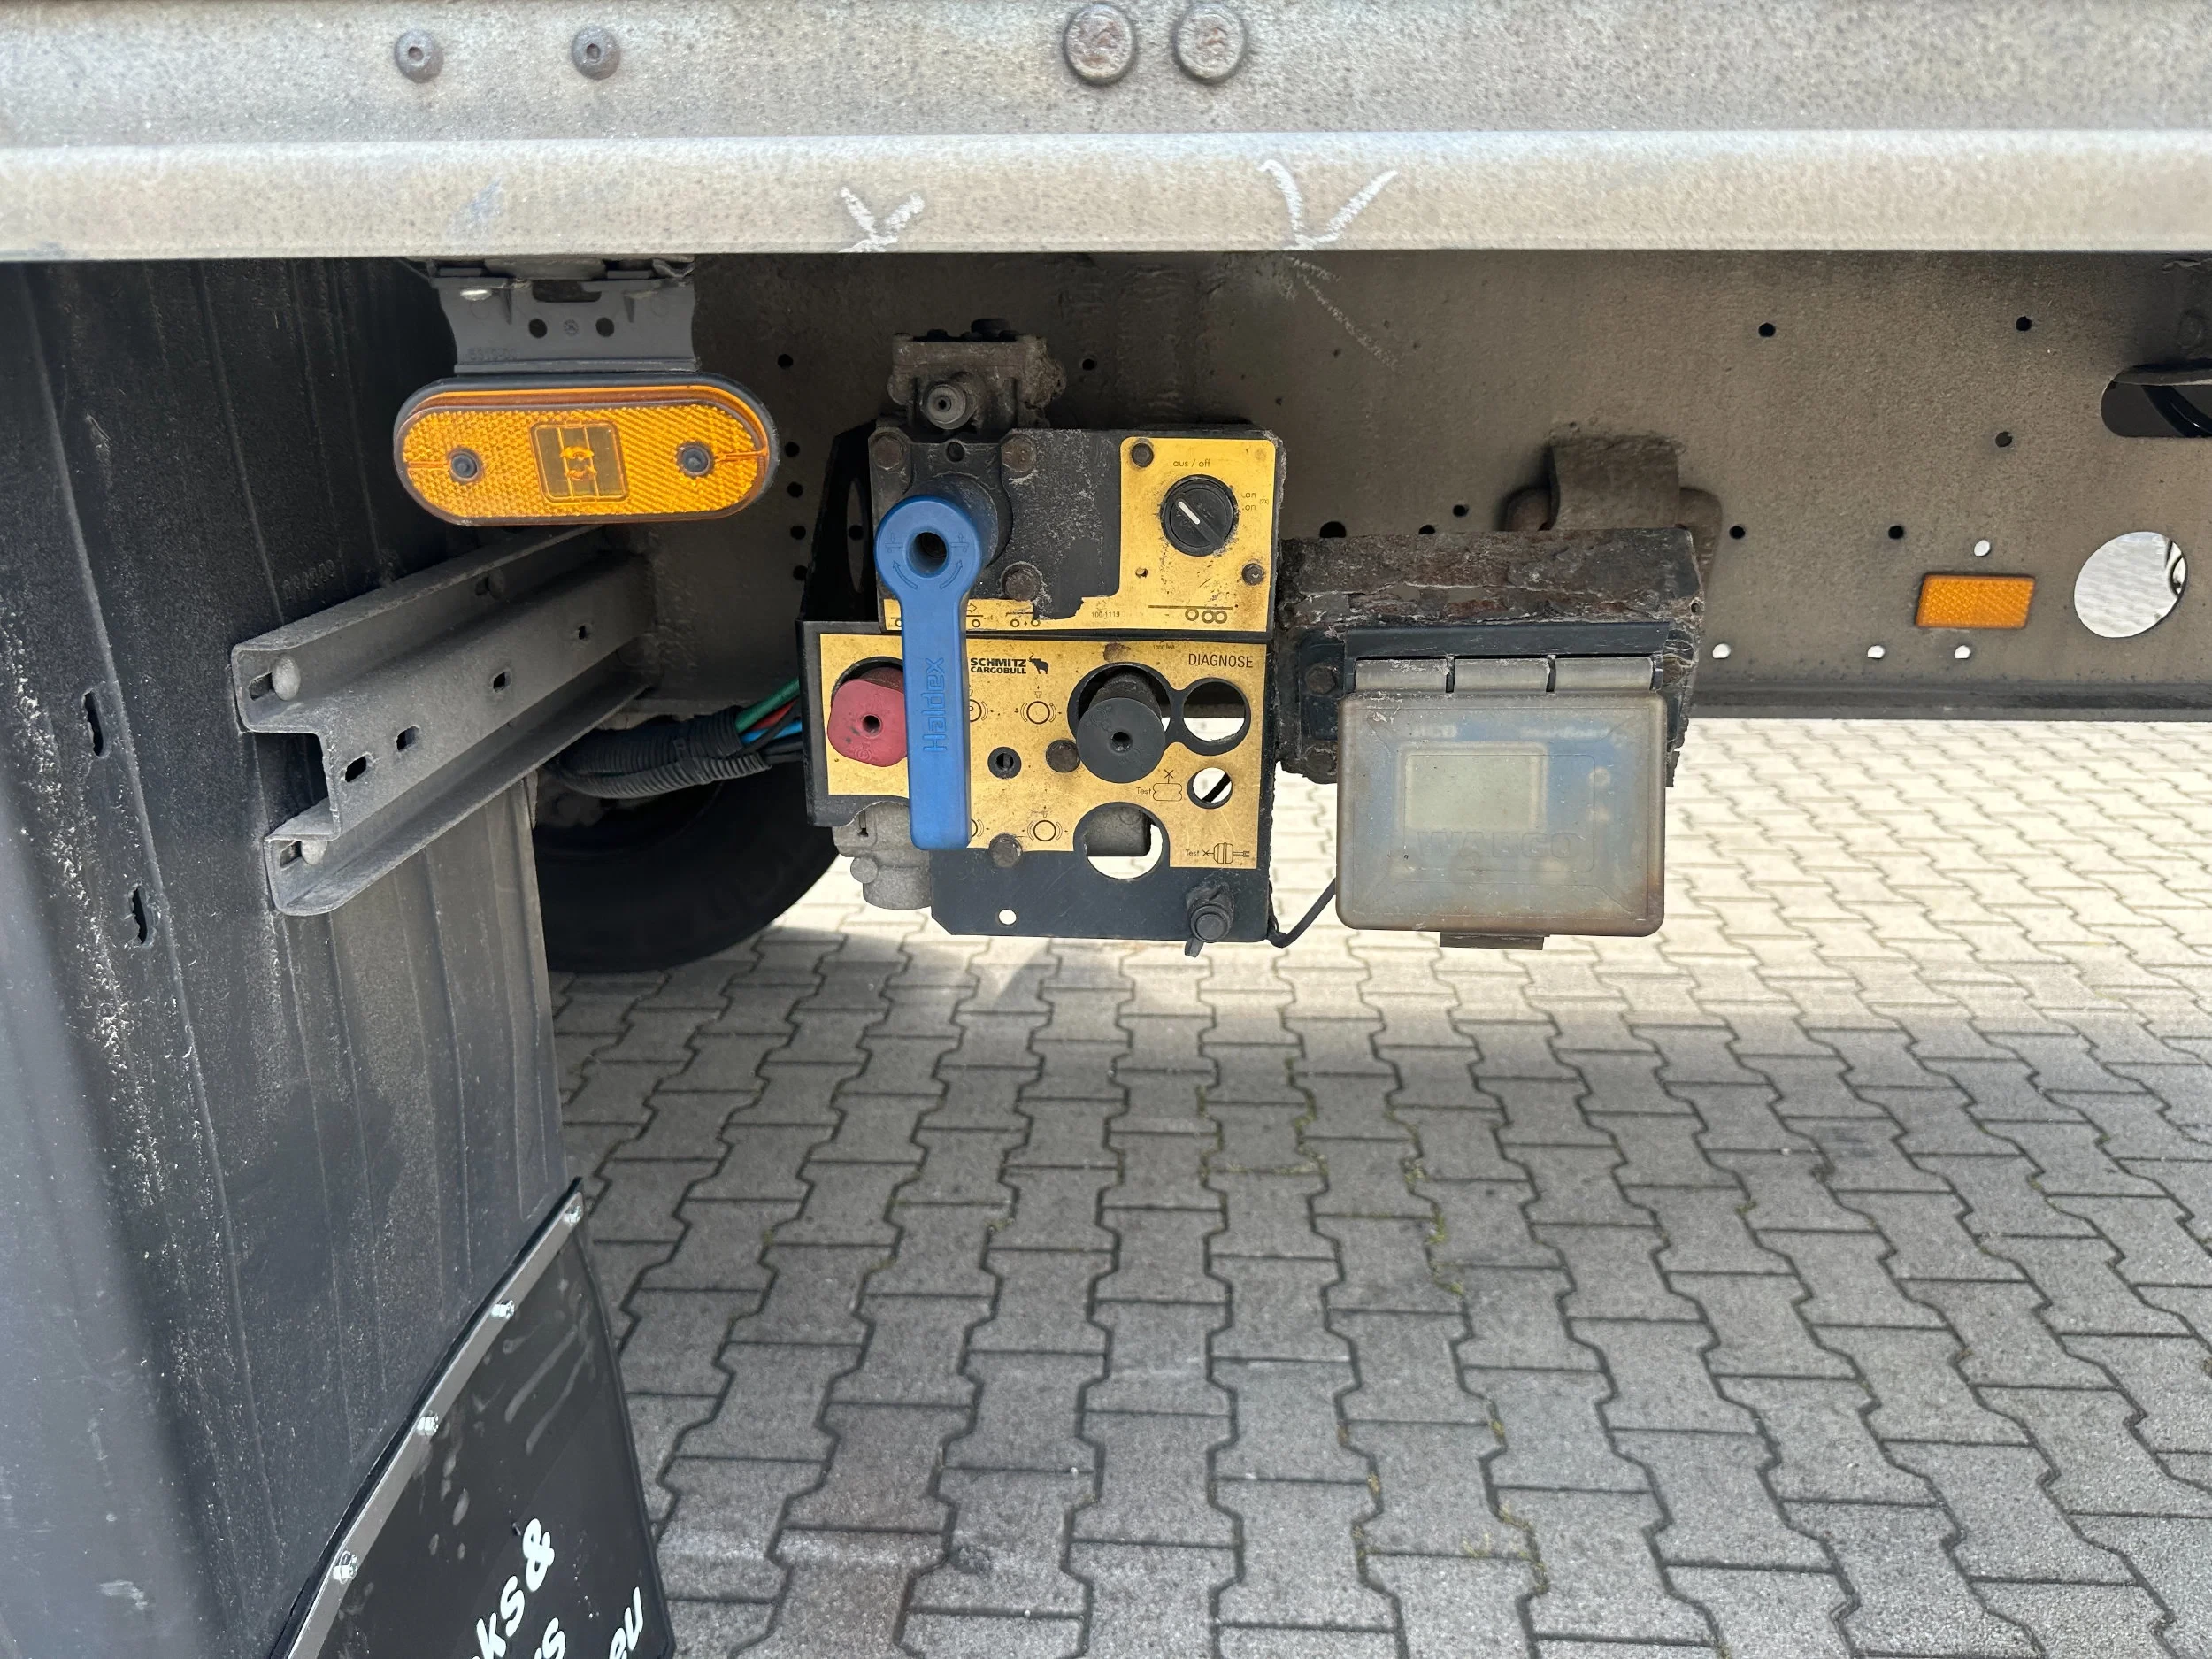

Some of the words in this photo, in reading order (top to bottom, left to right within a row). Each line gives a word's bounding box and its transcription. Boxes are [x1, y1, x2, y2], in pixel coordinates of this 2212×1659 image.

[1198, 458, 1211, 468] off
[970, 657, 1027, 667] SCHMITZ
[1188, 653, 1254, 669] DIAGNOSE
[920, 657, 948, 751] Haldex
[472, 1575, 526, 1659] ks
[522, 1517, 556, 1592] &
